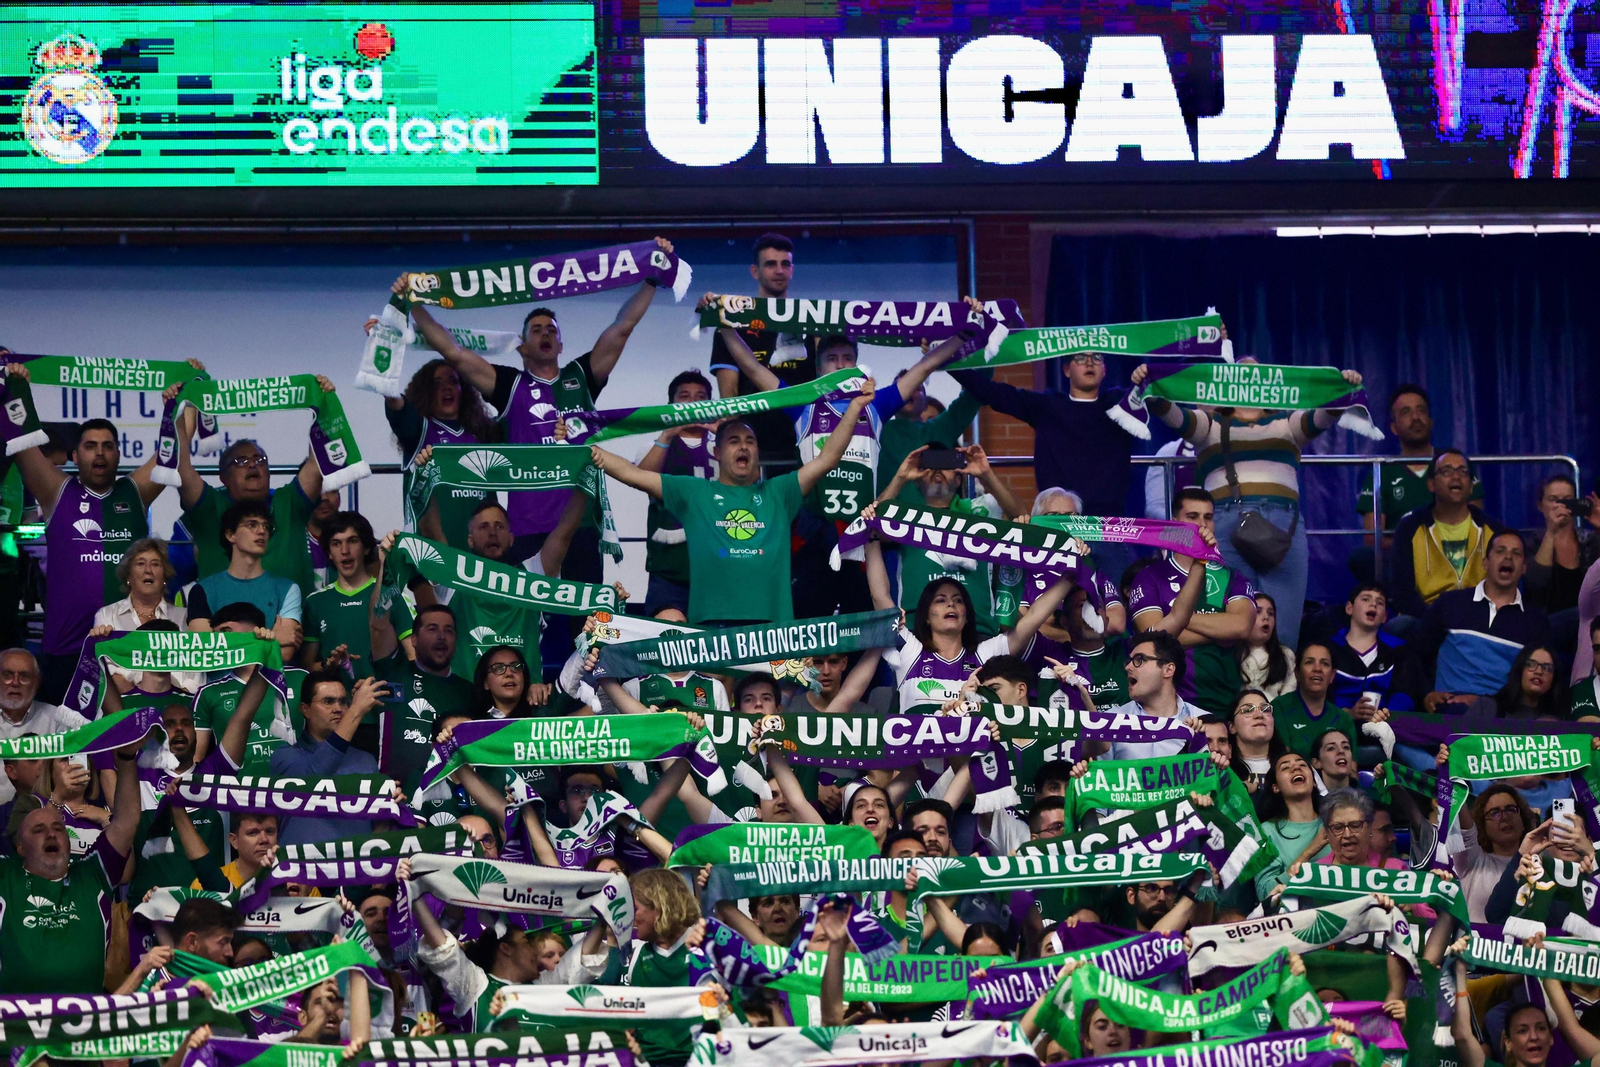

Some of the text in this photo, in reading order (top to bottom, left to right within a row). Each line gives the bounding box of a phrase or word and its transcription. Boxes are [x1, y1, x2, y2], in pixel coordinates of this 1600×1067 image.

[281, 54, 383, 110] liga
[644, 34, 1406, 167] UNICAJA
[283, 107, 509, 154] endesa
[450, 249, 640, 298] UNICAJA
[767, 298, 953, 327] UNICAJA
[1023, 335, 1128, 357] BALONCESTO
[59, 366, 165, 388] BALONCESTO
[1211, 364, 1285, 386] UNICAJA
[202, 386, 306, 412] BALONCESTO
[1196, 380, 1300, 405] BALONCESTO
[842, 448, 870, 461] nicaja
[508, 465, 570, 481] Unicaja
[823, 489, 858, 514] 33
[98, 528, 133, 540] Unicaja
[880, 503, 1079, 569] UNICAJA
[1066, 523, 1140, 534] FINAL FOUR
[80, 550, 125, 565] málag
[455, 553, 616, 611] Unicaja
[148, 632, 228, 650] UNICAJA
[494, 634, 524, 645] Unicaja
[637, 621, 861, 667] MALAGA UNICAJA BALONCESTO MALAGA
[131, 648, 246, 668] BALONCESTO
[530, 718, 612, 741] UNICAJA
[797, 715, 991, 747] UNICAJA
[513, 738, 631, 761] BALONCESTO
[1482, 734, 1562, 753] UNICAJA
[1467, 748, 1582, 775] BALONCESTO
[1074, 758, 1216, 797] ICAJA CAMPE
[178, 774, 401, 815] UNICAJA
[1110, 788, 1185, 803] COPA DEL REY 2023
[746, 826, 826, 846] UNICAJA
[733, 857, 920, 886] MALAGA UNICAJA BALONCE
[503, 887, 564, 909] Unicaja
[243, 905, 281, 925] caja
[1225, 916, 1294, 943] Unicaja
[1472, 937, 1547, 971] UNICAJA
[868, 955, 980, 984] CAMPEÓN
[857, 984, 872, 994] DEL
[874, 984, 889, 995] REY
[891, 984, 912, 995] 2023
[1098, 970, 1197, 1018] UNICAJA
[603, 996, 646, 1010] Unicaja
[1163, 1003, 1242, 1027] COPA DEL REY 2023
[858, 1033, 928, 1053] Unicaja
[1175, 1037, 1307, 1067] BALONCESTO
